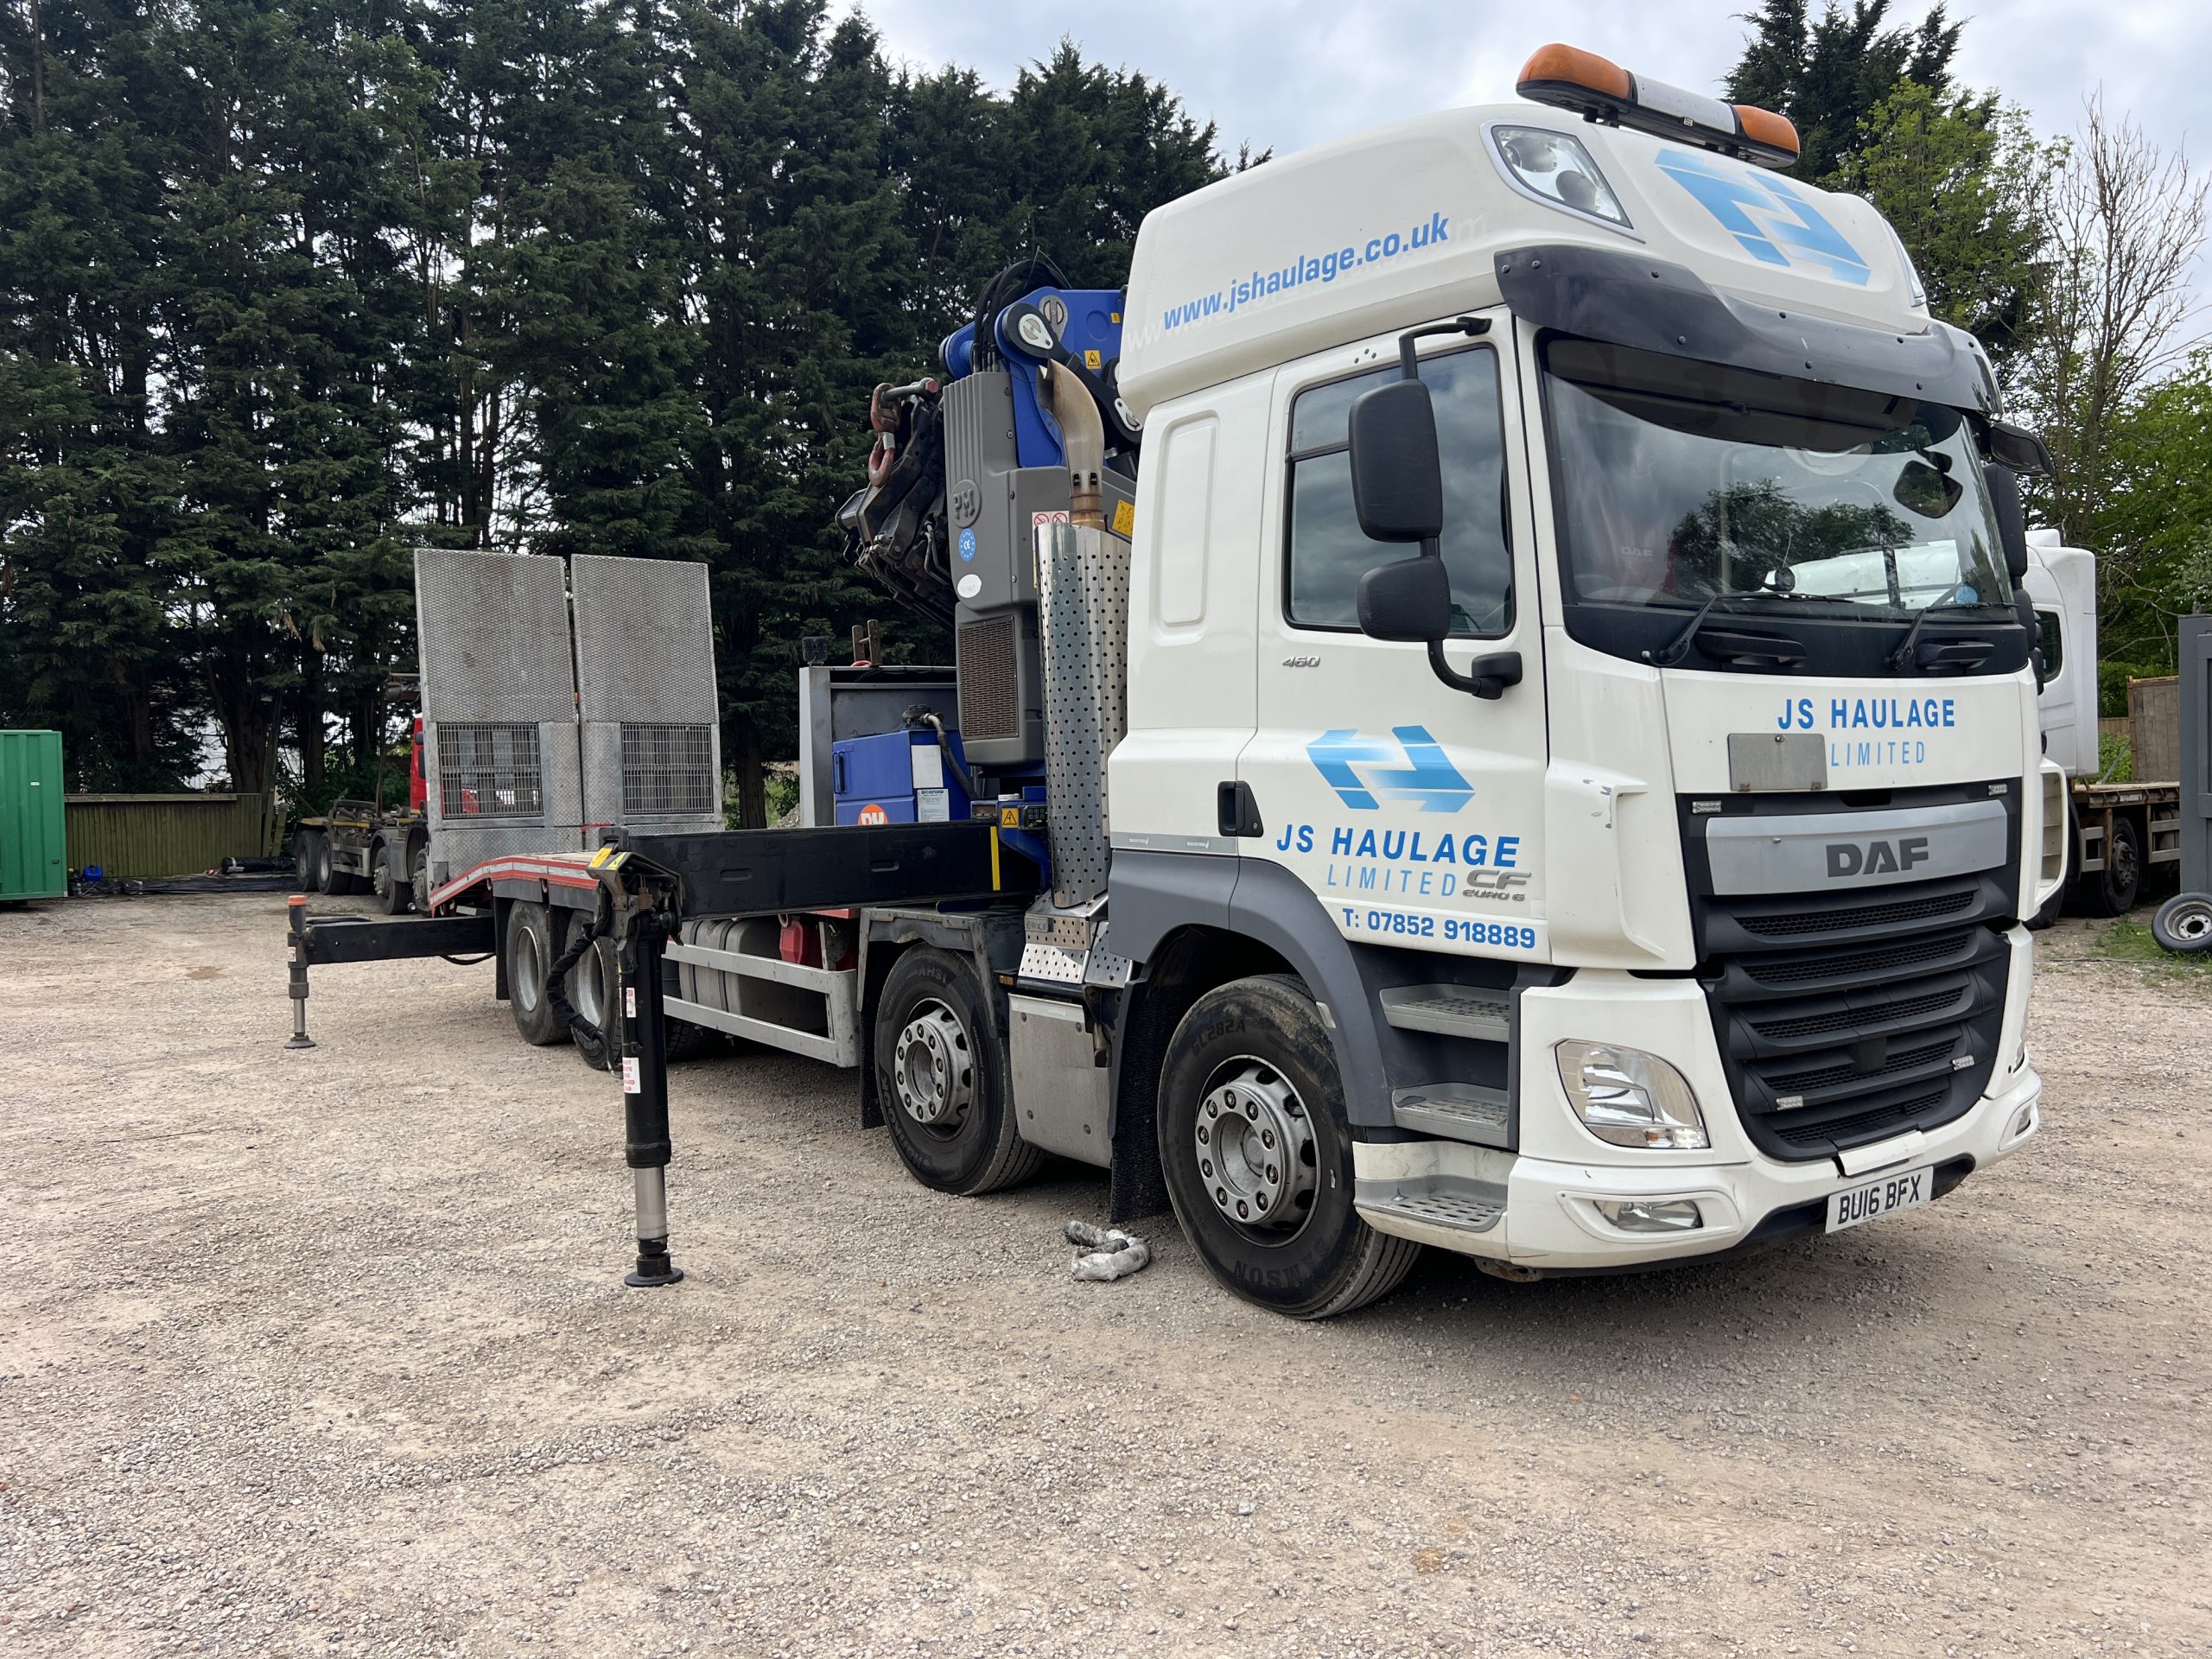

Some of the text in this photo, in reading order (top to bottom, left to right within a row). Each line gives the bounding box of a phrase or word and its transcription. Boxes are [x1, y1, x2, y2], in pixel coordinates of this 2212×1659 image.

[1163, 212, 1450, 331] www.jshaulage.co.uk
[1621, 546, 1654, 557] DAF
[1281, 656, 1321, 668] 460
[1777, 698, 1955, 730] JS HAULAGE
[1831, 741, 1925, 766] LIMITED
[1276, 823, 1521, 868] JS HAULAGE
[1825, 836, 1929, 878] DAF
[1327, 864, 1457, 897] LIMITED
[1462, 889, 1525, 901] EURO 6
[1466, 869, 1532, 890] CF
[1342, 907, 1536, 949] T: 07852 918889
[1838, 1174, 1921, 1224] BU16 BFX
